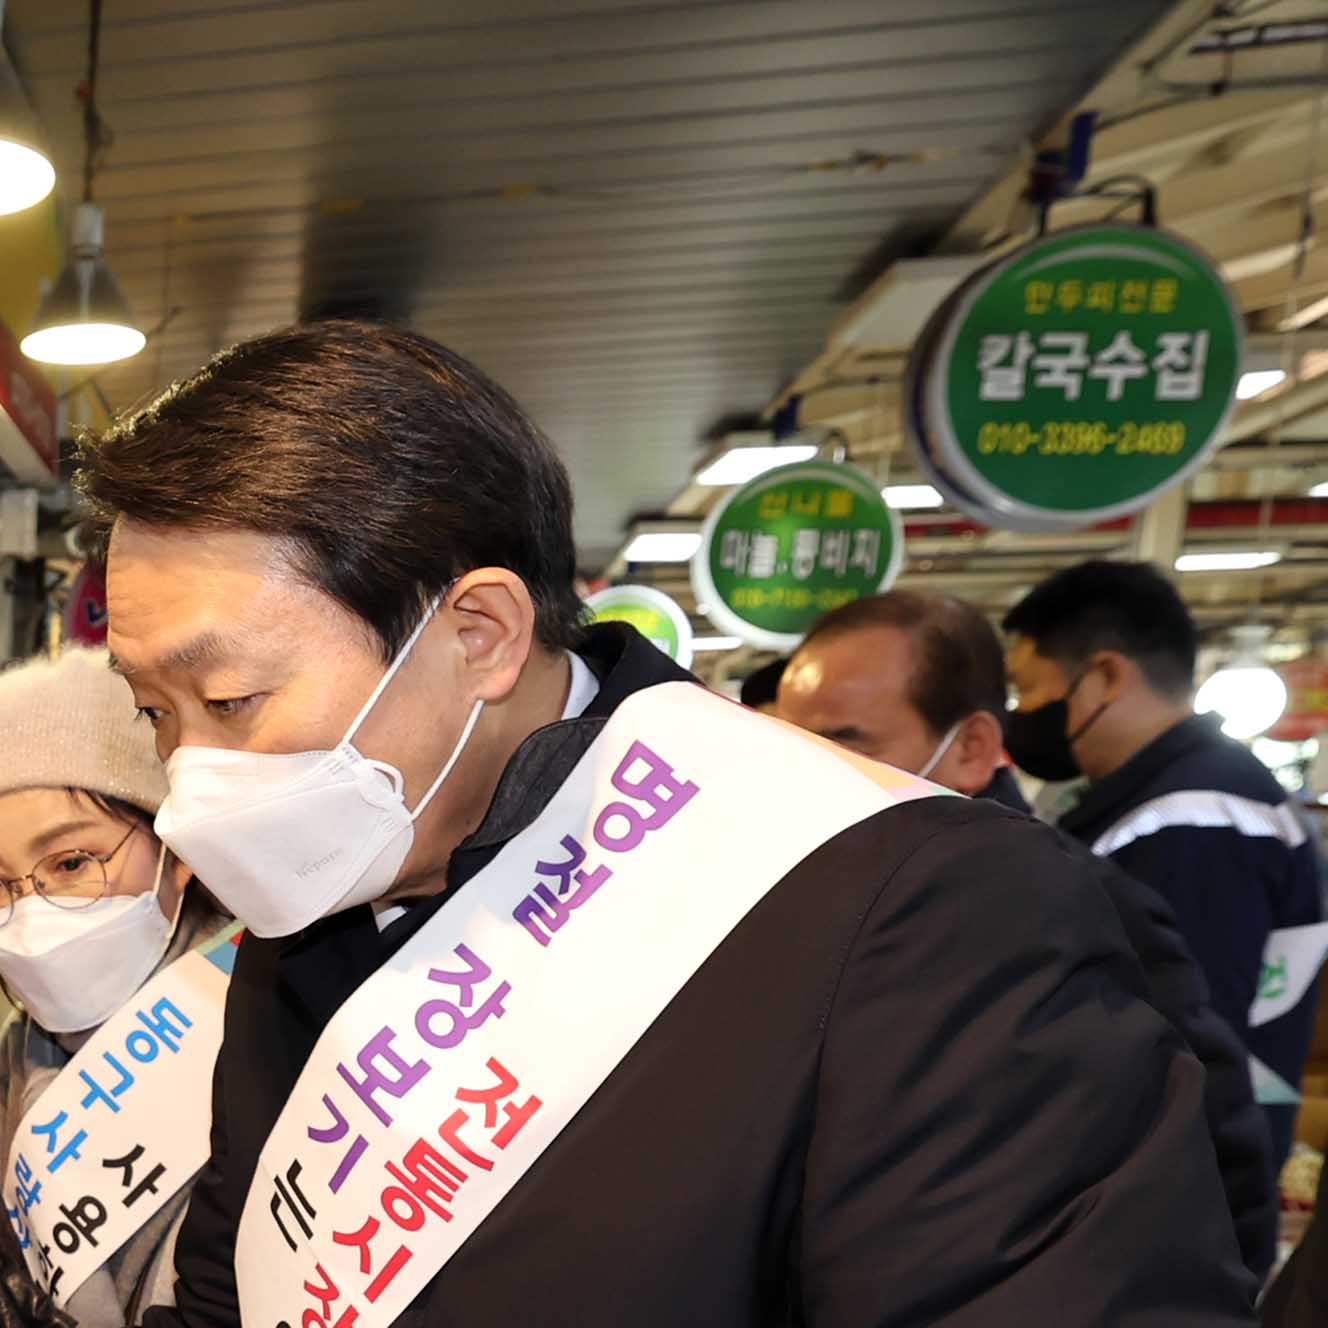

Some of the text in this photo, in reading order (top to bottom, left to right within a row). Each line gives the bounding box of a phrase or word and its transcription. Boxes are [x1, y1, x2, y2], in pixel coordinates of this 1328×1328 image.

[977, 329, 1210, 401] 칼국수집
[269, 739, 701, 1253] 명절 장보기는
